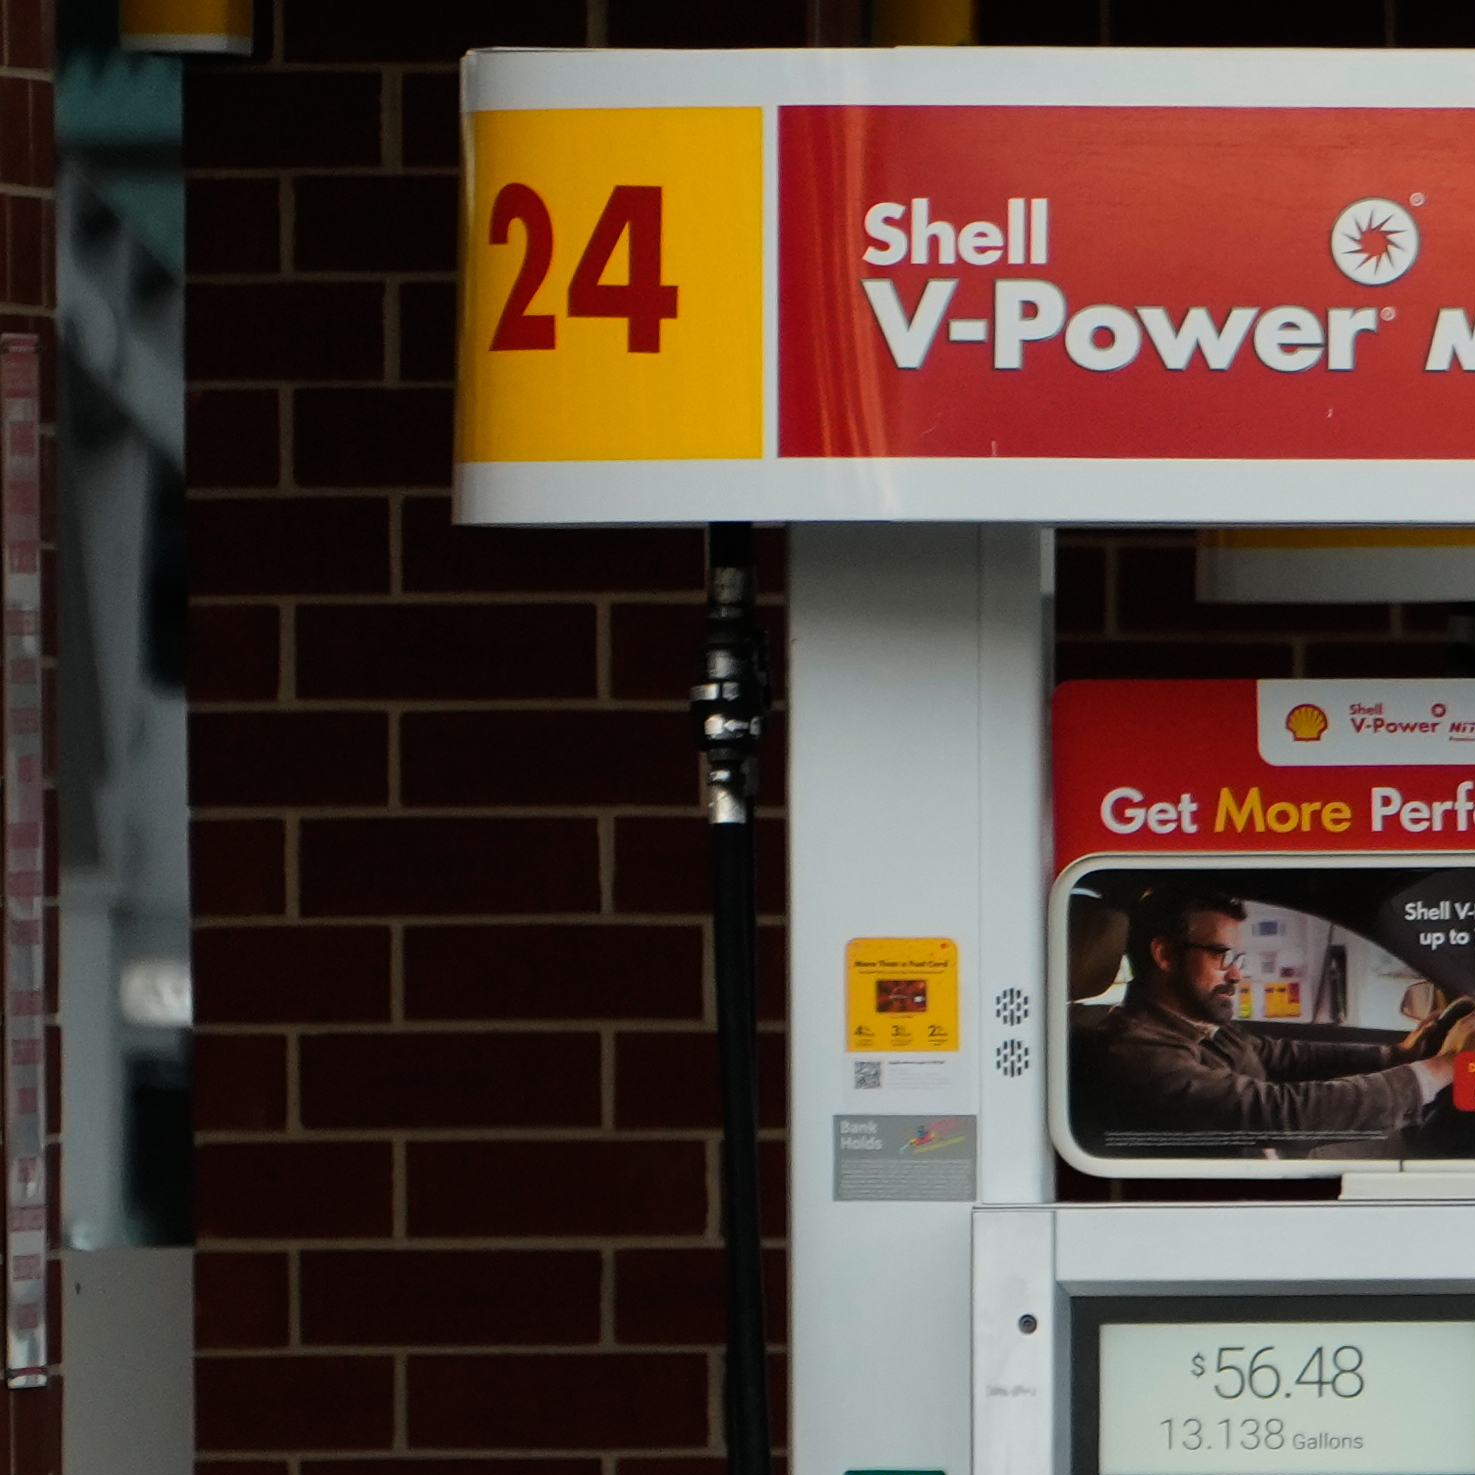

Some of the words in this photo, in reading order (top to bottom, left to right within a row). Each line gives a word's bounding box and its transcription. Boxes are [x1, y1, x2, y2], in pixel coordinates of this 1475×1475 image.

[862, 197, 1049, 266] Shell
[488, 182, 680, 353] 24
[862, 277, 1377, 374] V-Power
[1349, 703, 1383, 715] Shell
[1350, 718, 1440, 734] V-Power
[1101, 788, 1197, 834] Get
[1213, 787, 1352, 833] More
[1405, 901, 1449, 920] Shell
[1420, 932, 1444, 949] up
[1449, 929, 1469, 944] to
[841, 1121, 877, 1134] Bank
[841, 1136, 882, 1150] Holds
[1190, 1345, 1365, 1400] $56.48
[1161, 1418, 1286, 1450] 13.138
[1292, 1433, 1363, 1450] Gallons
